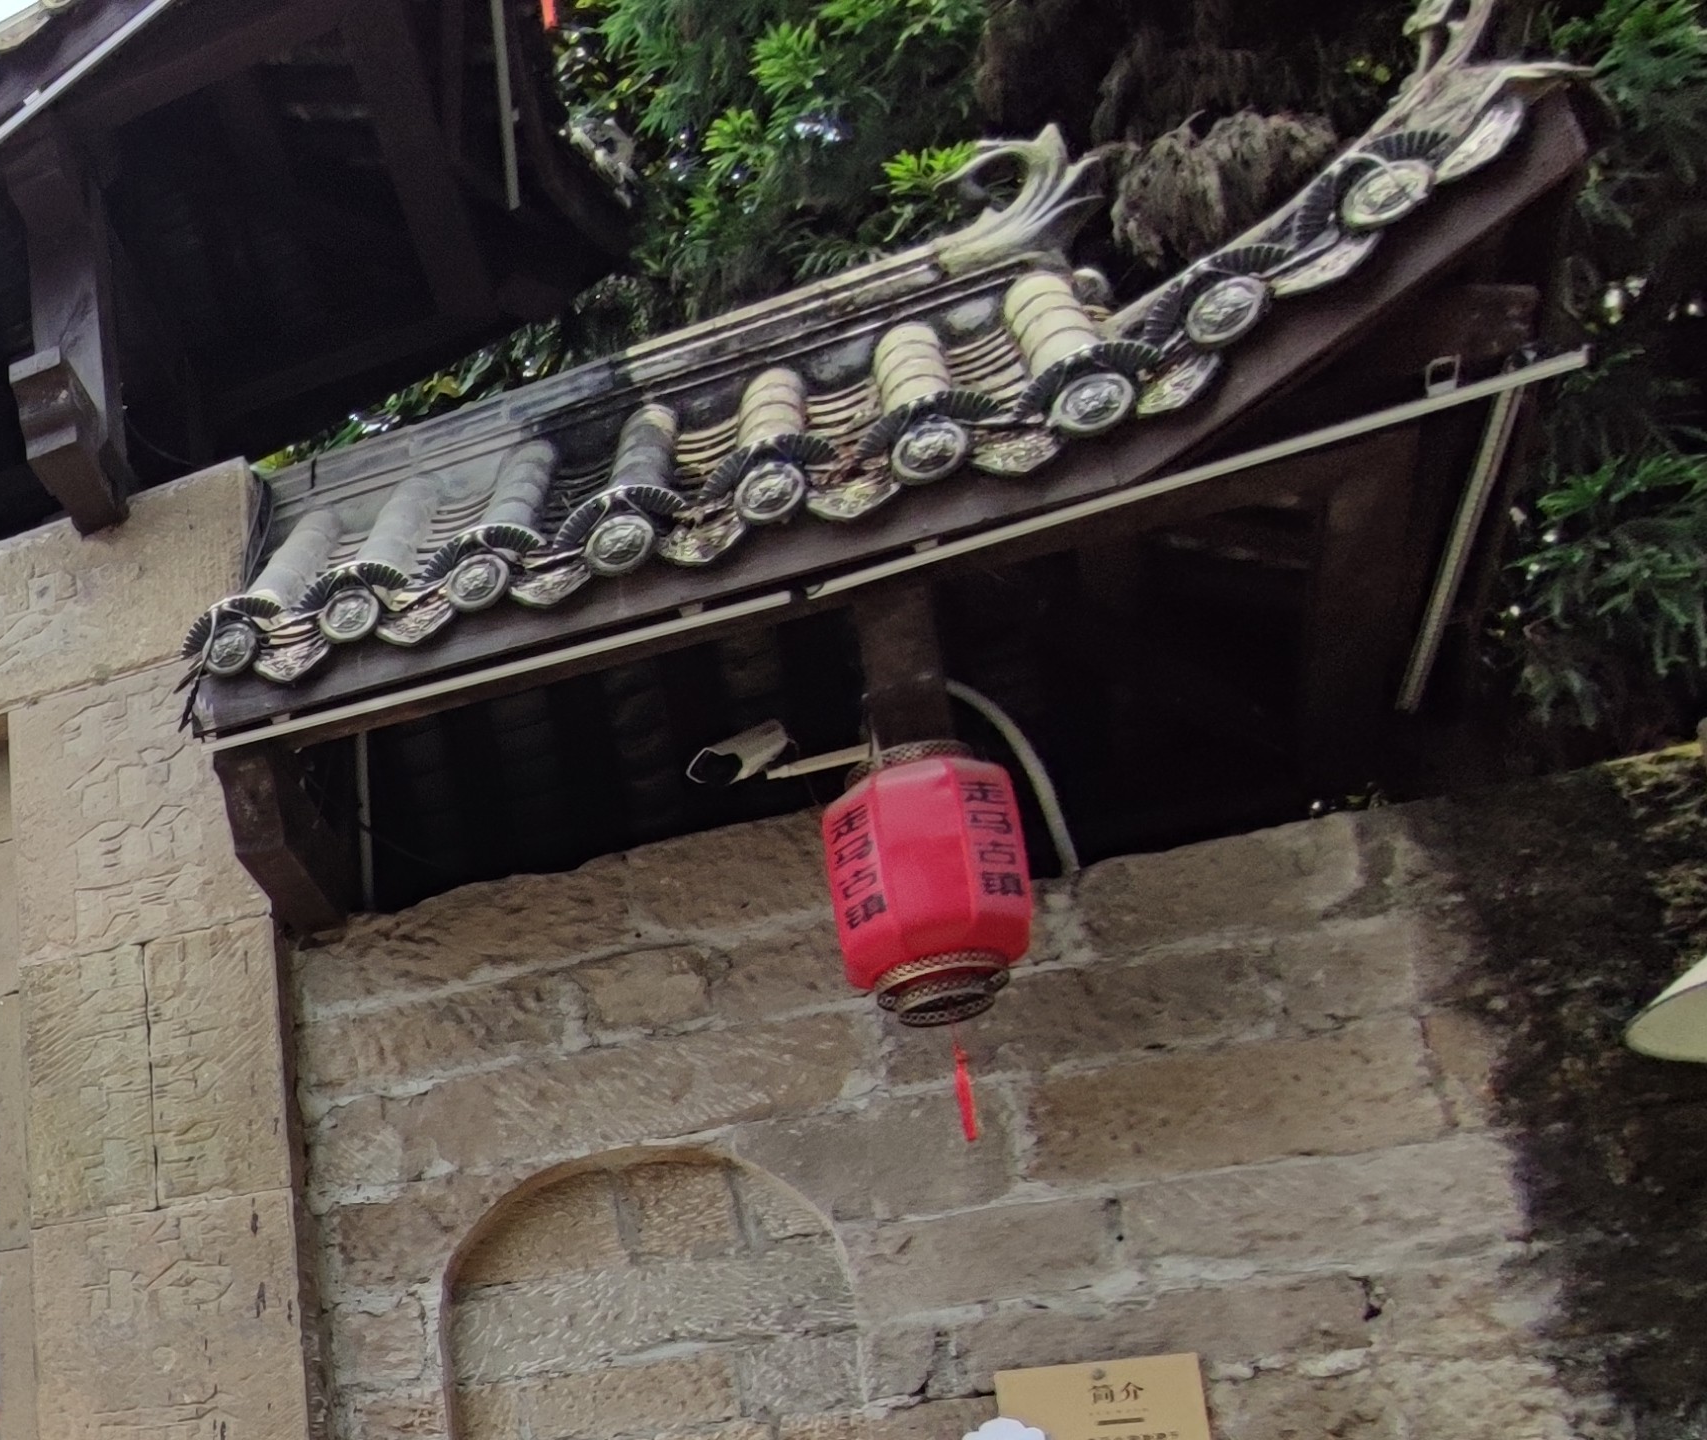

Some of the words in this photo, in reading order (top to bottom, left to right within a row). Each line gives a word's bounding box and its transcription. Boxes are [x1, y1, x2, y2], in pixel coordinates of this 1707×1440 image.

[829, 803, 887, 931] 走马古镇
[958, 780, 1025, 898] 走马古镇
[1088, 1381, 1145, 1405] 简介
